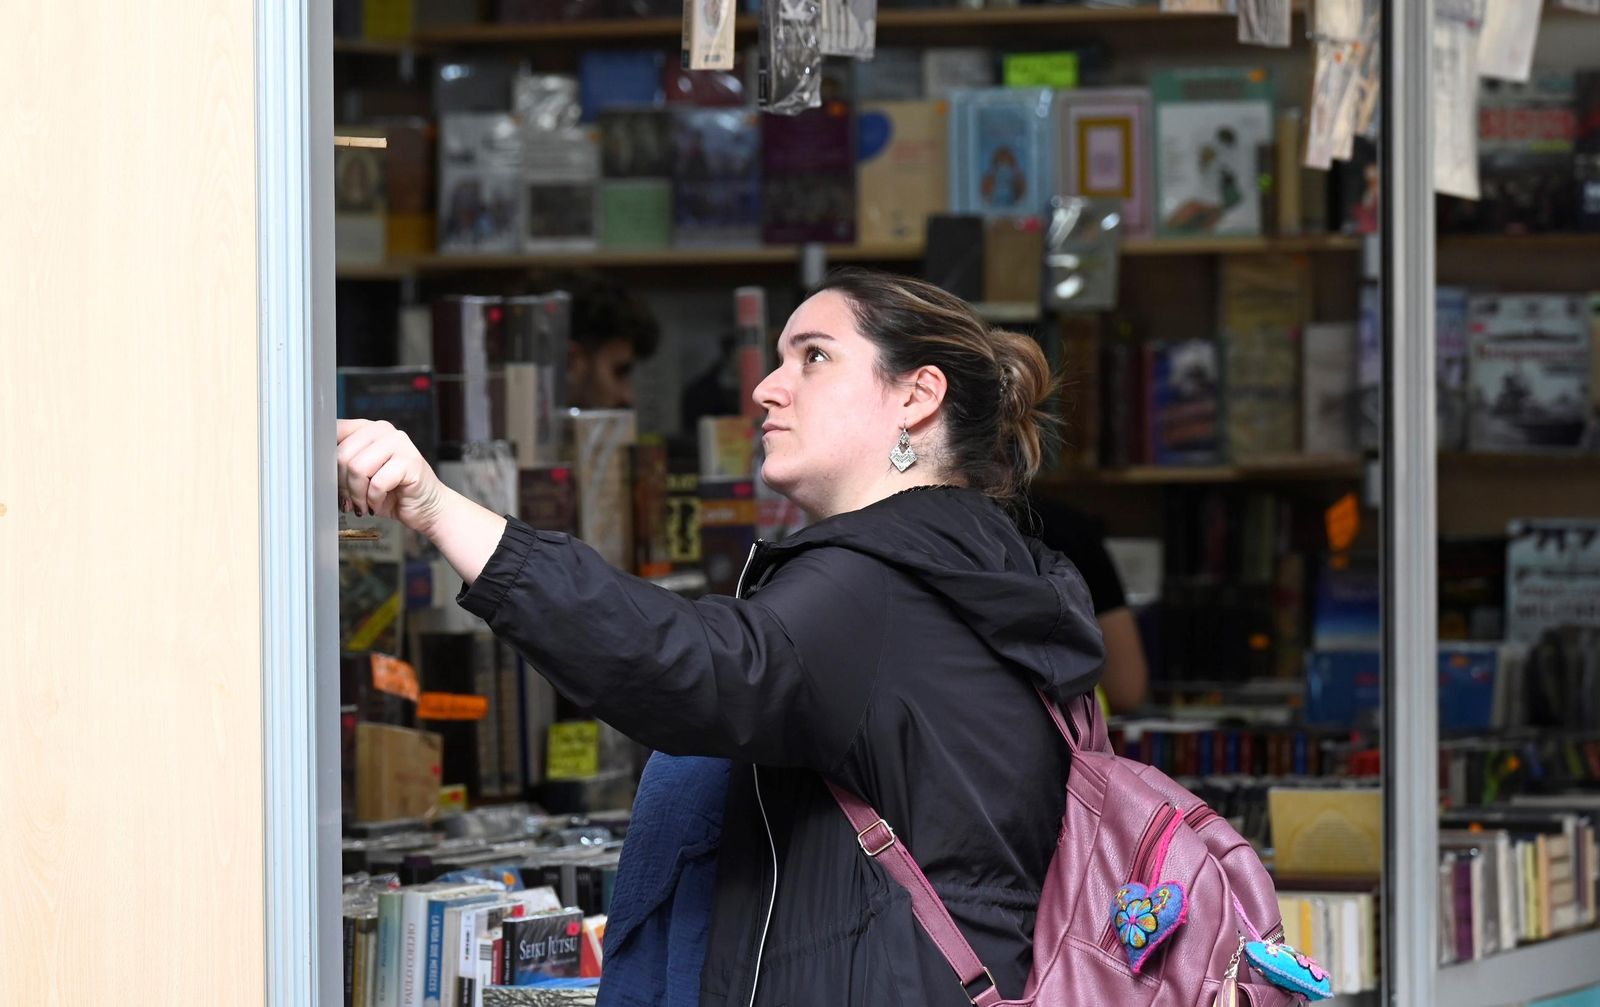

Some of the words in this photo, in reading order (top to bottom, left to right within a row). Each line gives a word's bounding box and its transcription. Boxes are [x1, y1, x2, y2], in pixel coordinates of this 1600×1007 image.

[431, 915, 440, 925] LA
[407, 922, 415, 968] COELHO
[431, 926, 439, 942] VIDA
[405, 969, 414, 1005] PAULO
